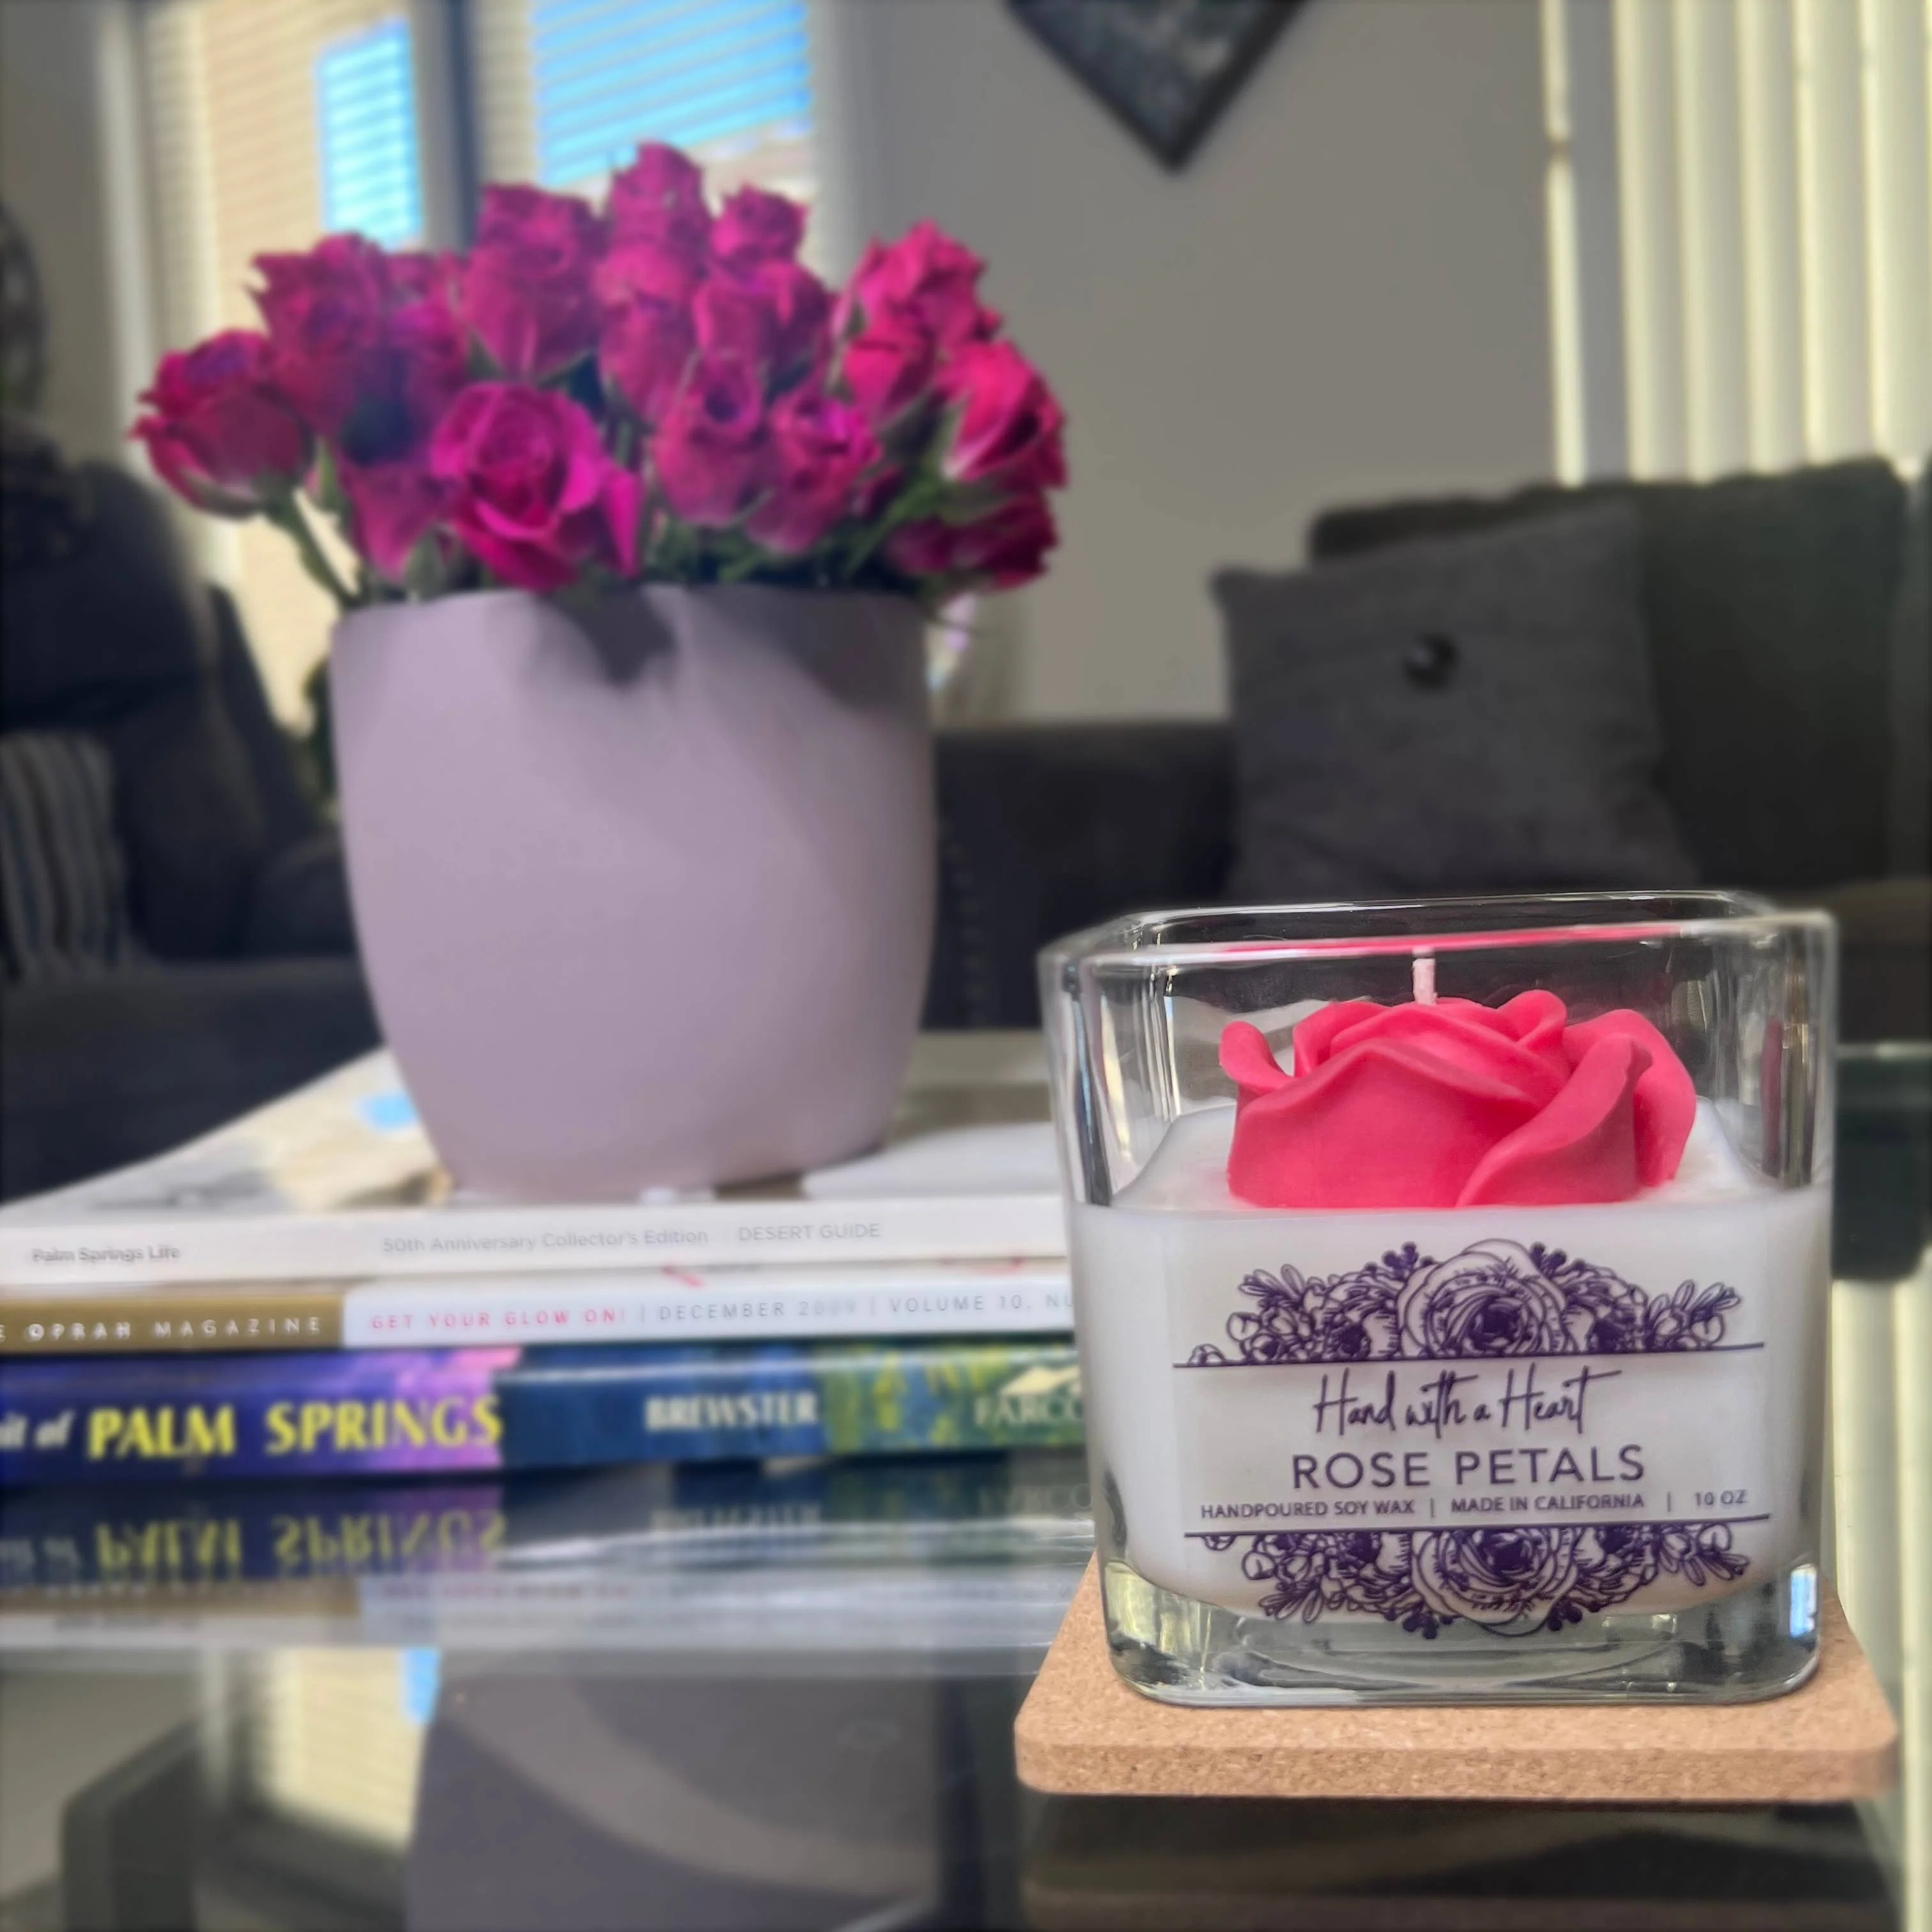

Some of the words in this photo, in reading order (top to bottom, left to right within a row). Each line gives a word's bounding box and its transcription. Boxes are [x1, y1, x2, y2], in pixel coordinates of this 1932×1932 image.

[383, 1237, 424, 1252] 50th
[429, 1234, 536, 1252] Anniversary
[542, 1230, 639, 1248] Collector's
[644, 1229, 708, 1245] Edition
[739, 1225, 813, 1241] DESERT
[820, 1223, 881, 1238] GUIDE
[32, 1248, 75, 1262] Palm
[78, 1246, 144, 1265] Springs
[148, 1245, 180, 1259] Life
[659, 1301, 785, 1321] DECEMBER
[890, 1296, 984, 1312] VOLUME
[372, 1314, 413, 1329] GET
[429, 1312, 490, 1328] YOUR
[505, 1309, 569, 1326] GLOW
[585, 1307, 625, 1323] ON!
[27, 1321, 131, 1342] OPRAH
[153, 1317, 320, 1338] MAGAZINE
[1313, 1367, 1395, 1436] Hand
[1406, 1369, 1478, 1439] with
[1473, 1403, 1491, 1422] a
[1499, 1361, 1622, 1434] Heart
[646, 1392, 818, 1432] BREWSTER
[88, 1402, 235, 1459] PALM
[265, 1395, 504, 1456] SPRINGS
[1293, 1452, 1430, 1489] ROSE
[1455, 1444, 1644, 1485] PETALS
[1450, 1497, 1504, 1512] MADE
[1510, 1496, 1528, 1511] IN
[1535, 1493, 1644, 1510] CALIFORNIA
[1694, 1492, 1715, 1506] 10
[1721, 1490, 1748, 1505] OZ
[1201, 1502, 1328, 1519] HANDPOURED
[1334, 1501, 1368, 1515] SOY
[1374, 1499, 1414, 1515] WAX
